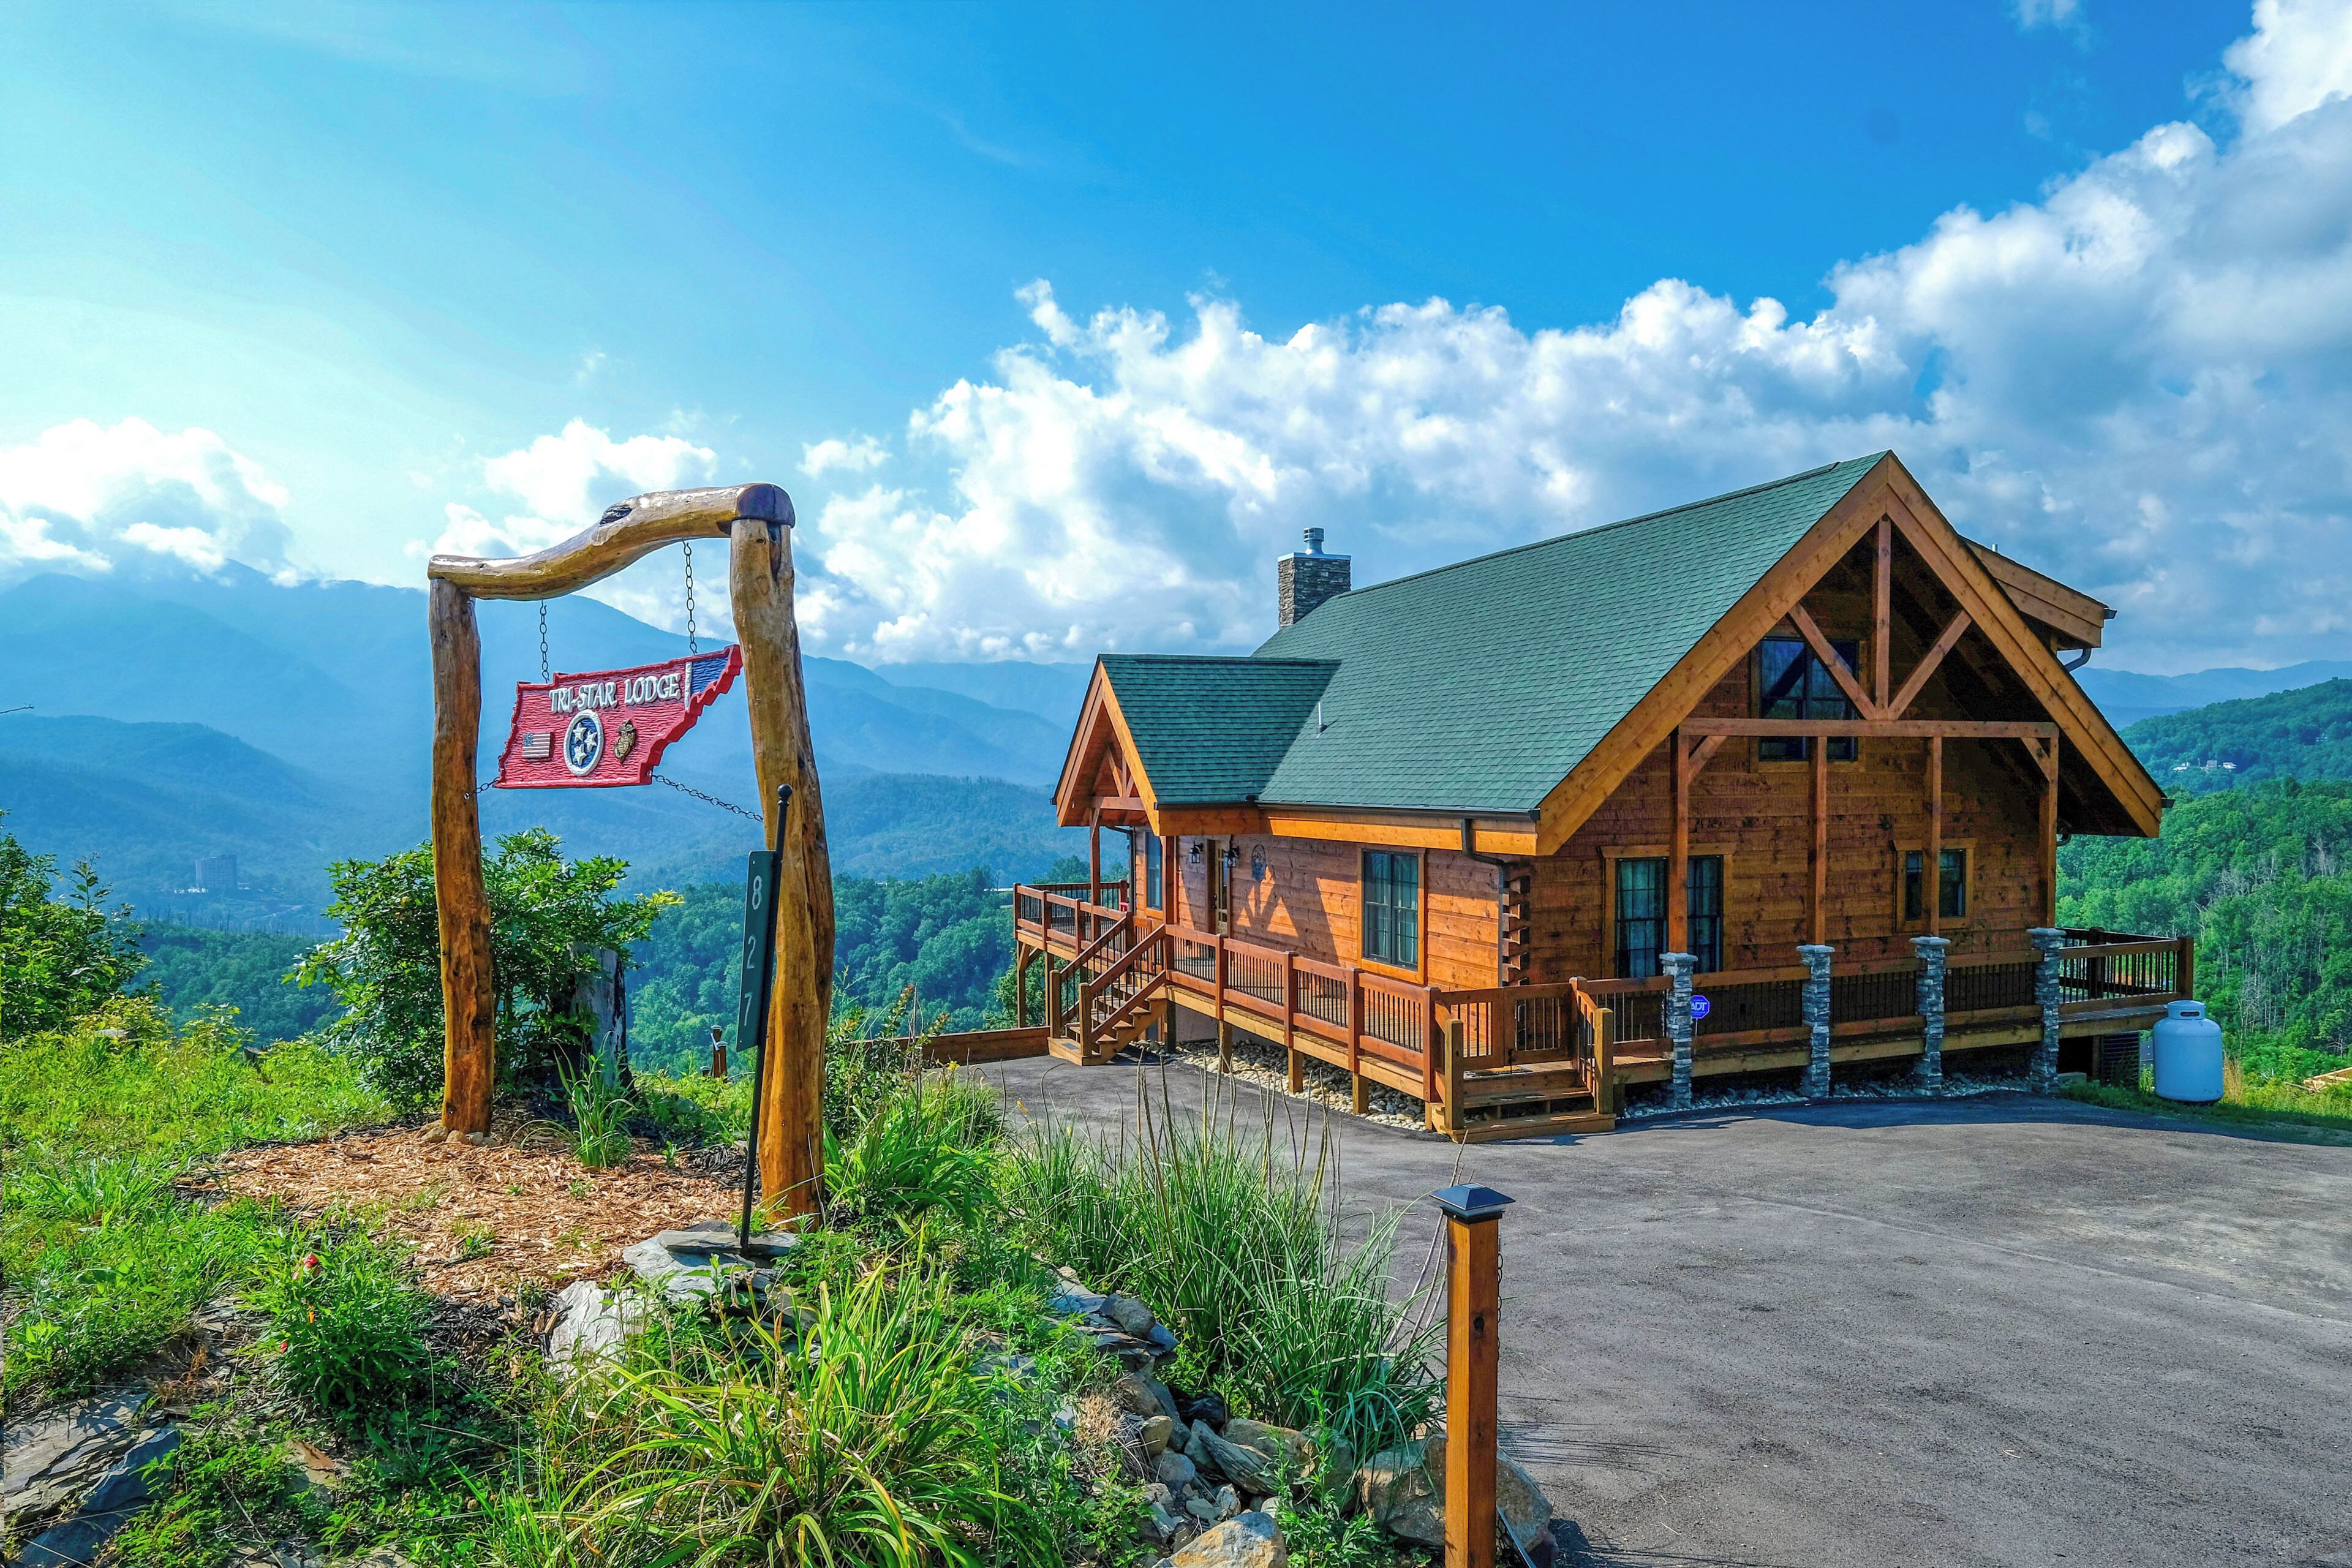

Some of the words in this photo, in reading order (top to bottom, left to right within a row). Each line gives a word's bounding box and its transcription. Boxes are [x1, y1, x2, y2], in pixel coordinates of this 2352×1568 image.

[549, 682, 617, 713] TRI-STAR
[624, 673, 681, 705] LODGE
[744, 875, 763, 1027] 827
[1691, 1001, 1707, 1011] ADT
